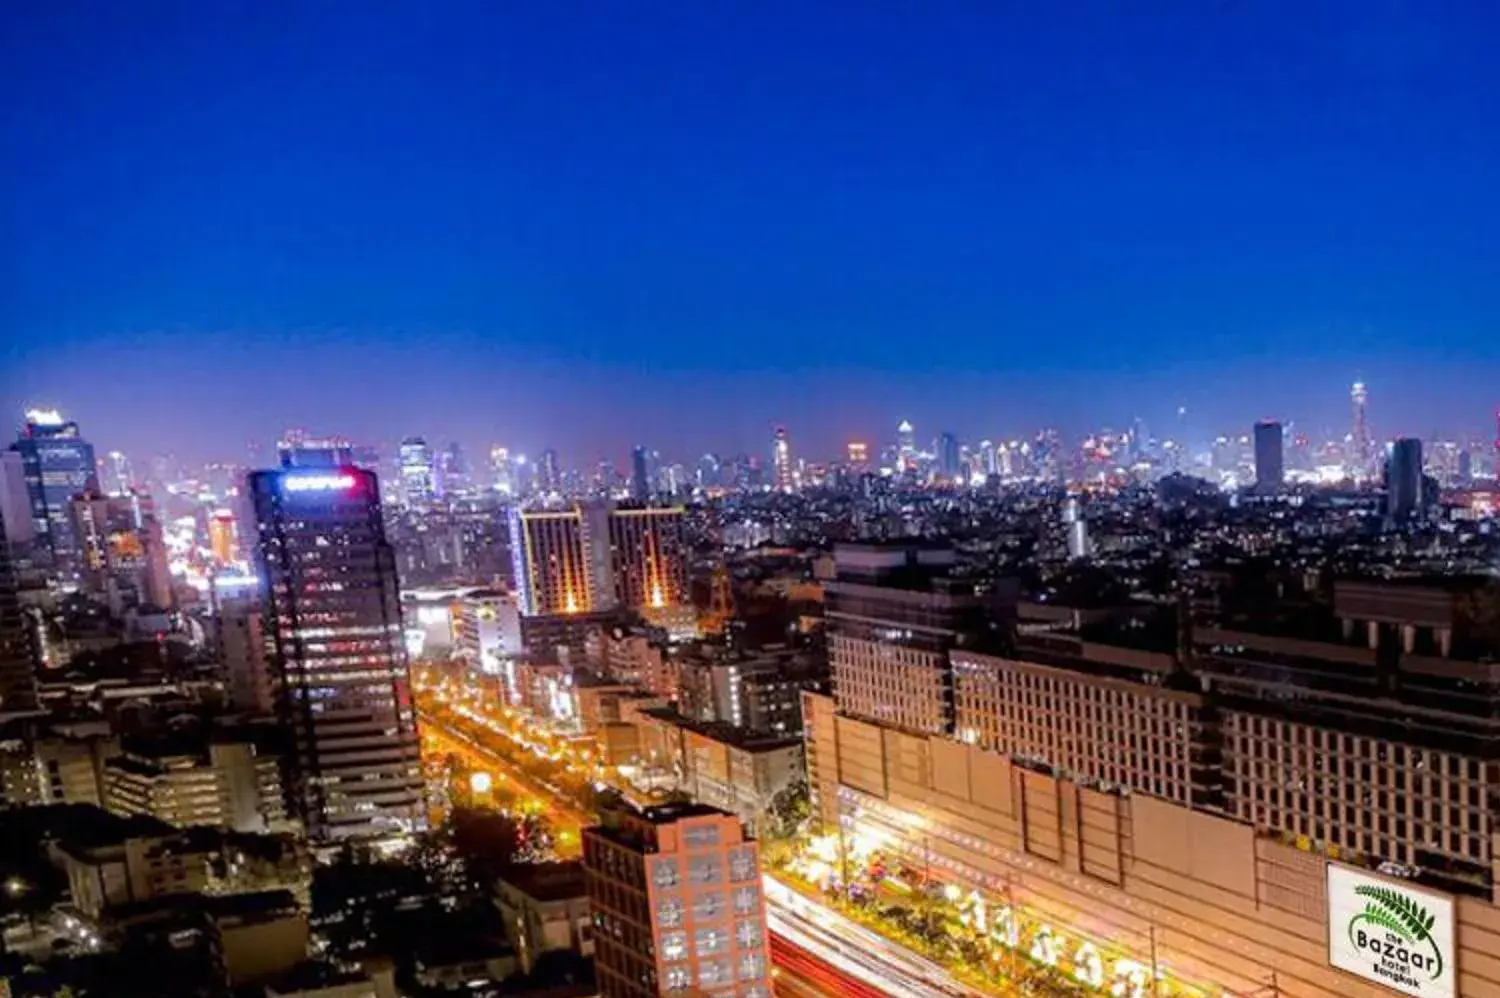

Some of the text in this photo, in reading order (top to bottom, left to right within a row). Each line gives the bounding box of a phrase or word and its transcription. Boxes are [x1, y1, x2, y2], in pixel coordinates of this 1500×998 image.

[1385, 933, 1403, 944] the
[1357, 930, 1434, 971] Bazaar
[1381, 957, 1411, 974] hotel
[1373, 964, 1420, 988] Bangkok
